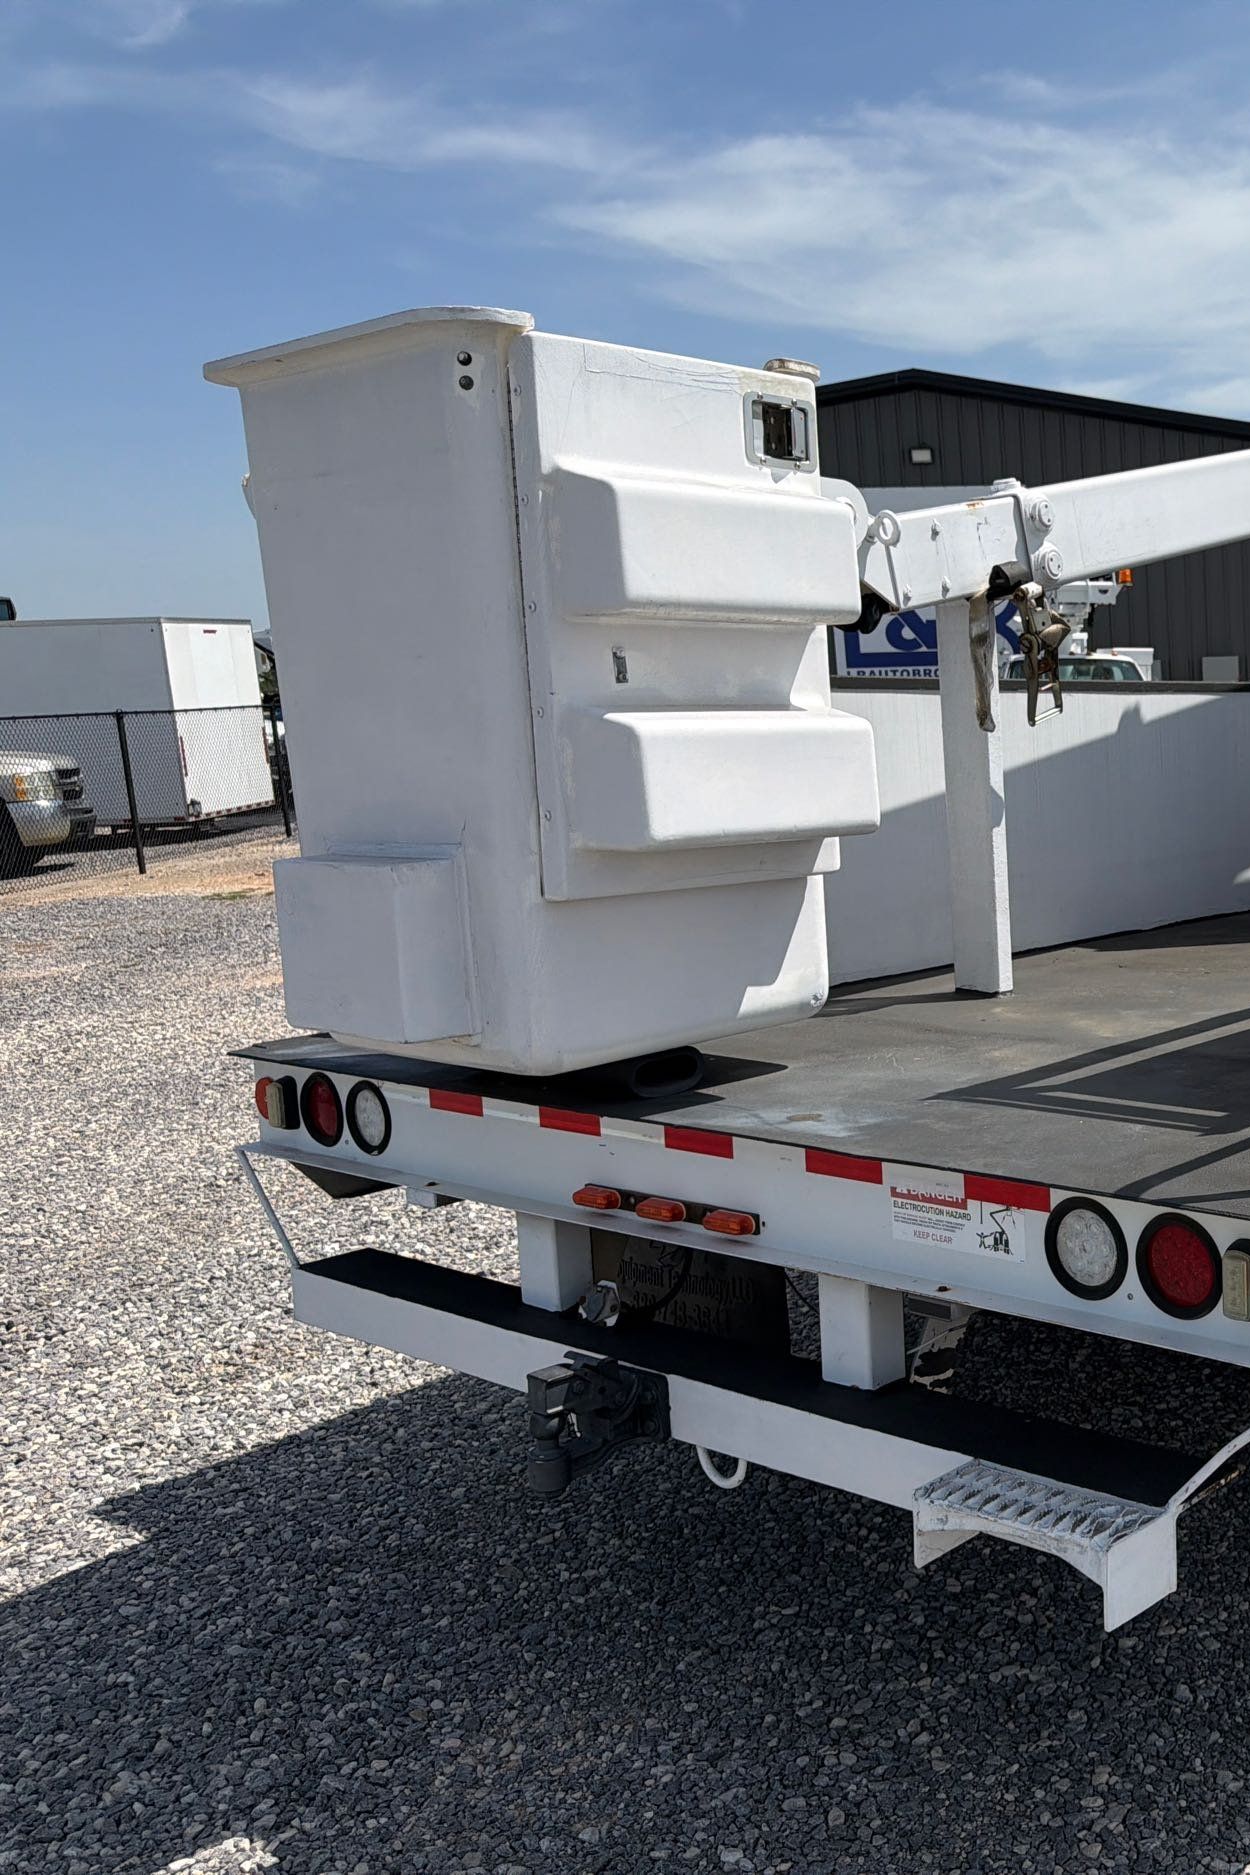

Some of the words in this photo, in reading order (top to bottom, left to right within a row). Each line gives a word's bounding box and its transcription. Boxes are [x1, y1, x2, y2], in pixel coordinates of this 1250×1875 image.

[893, 1200, 945, 1216] ELECTROCUTION
[945, 1208, 972, 1222] HAZARD
[913, 1229, 931, 1240] KEEP
[931, 1233, 954, 1245] CLEAR
[617, 1257, 664, 1288] quipment
